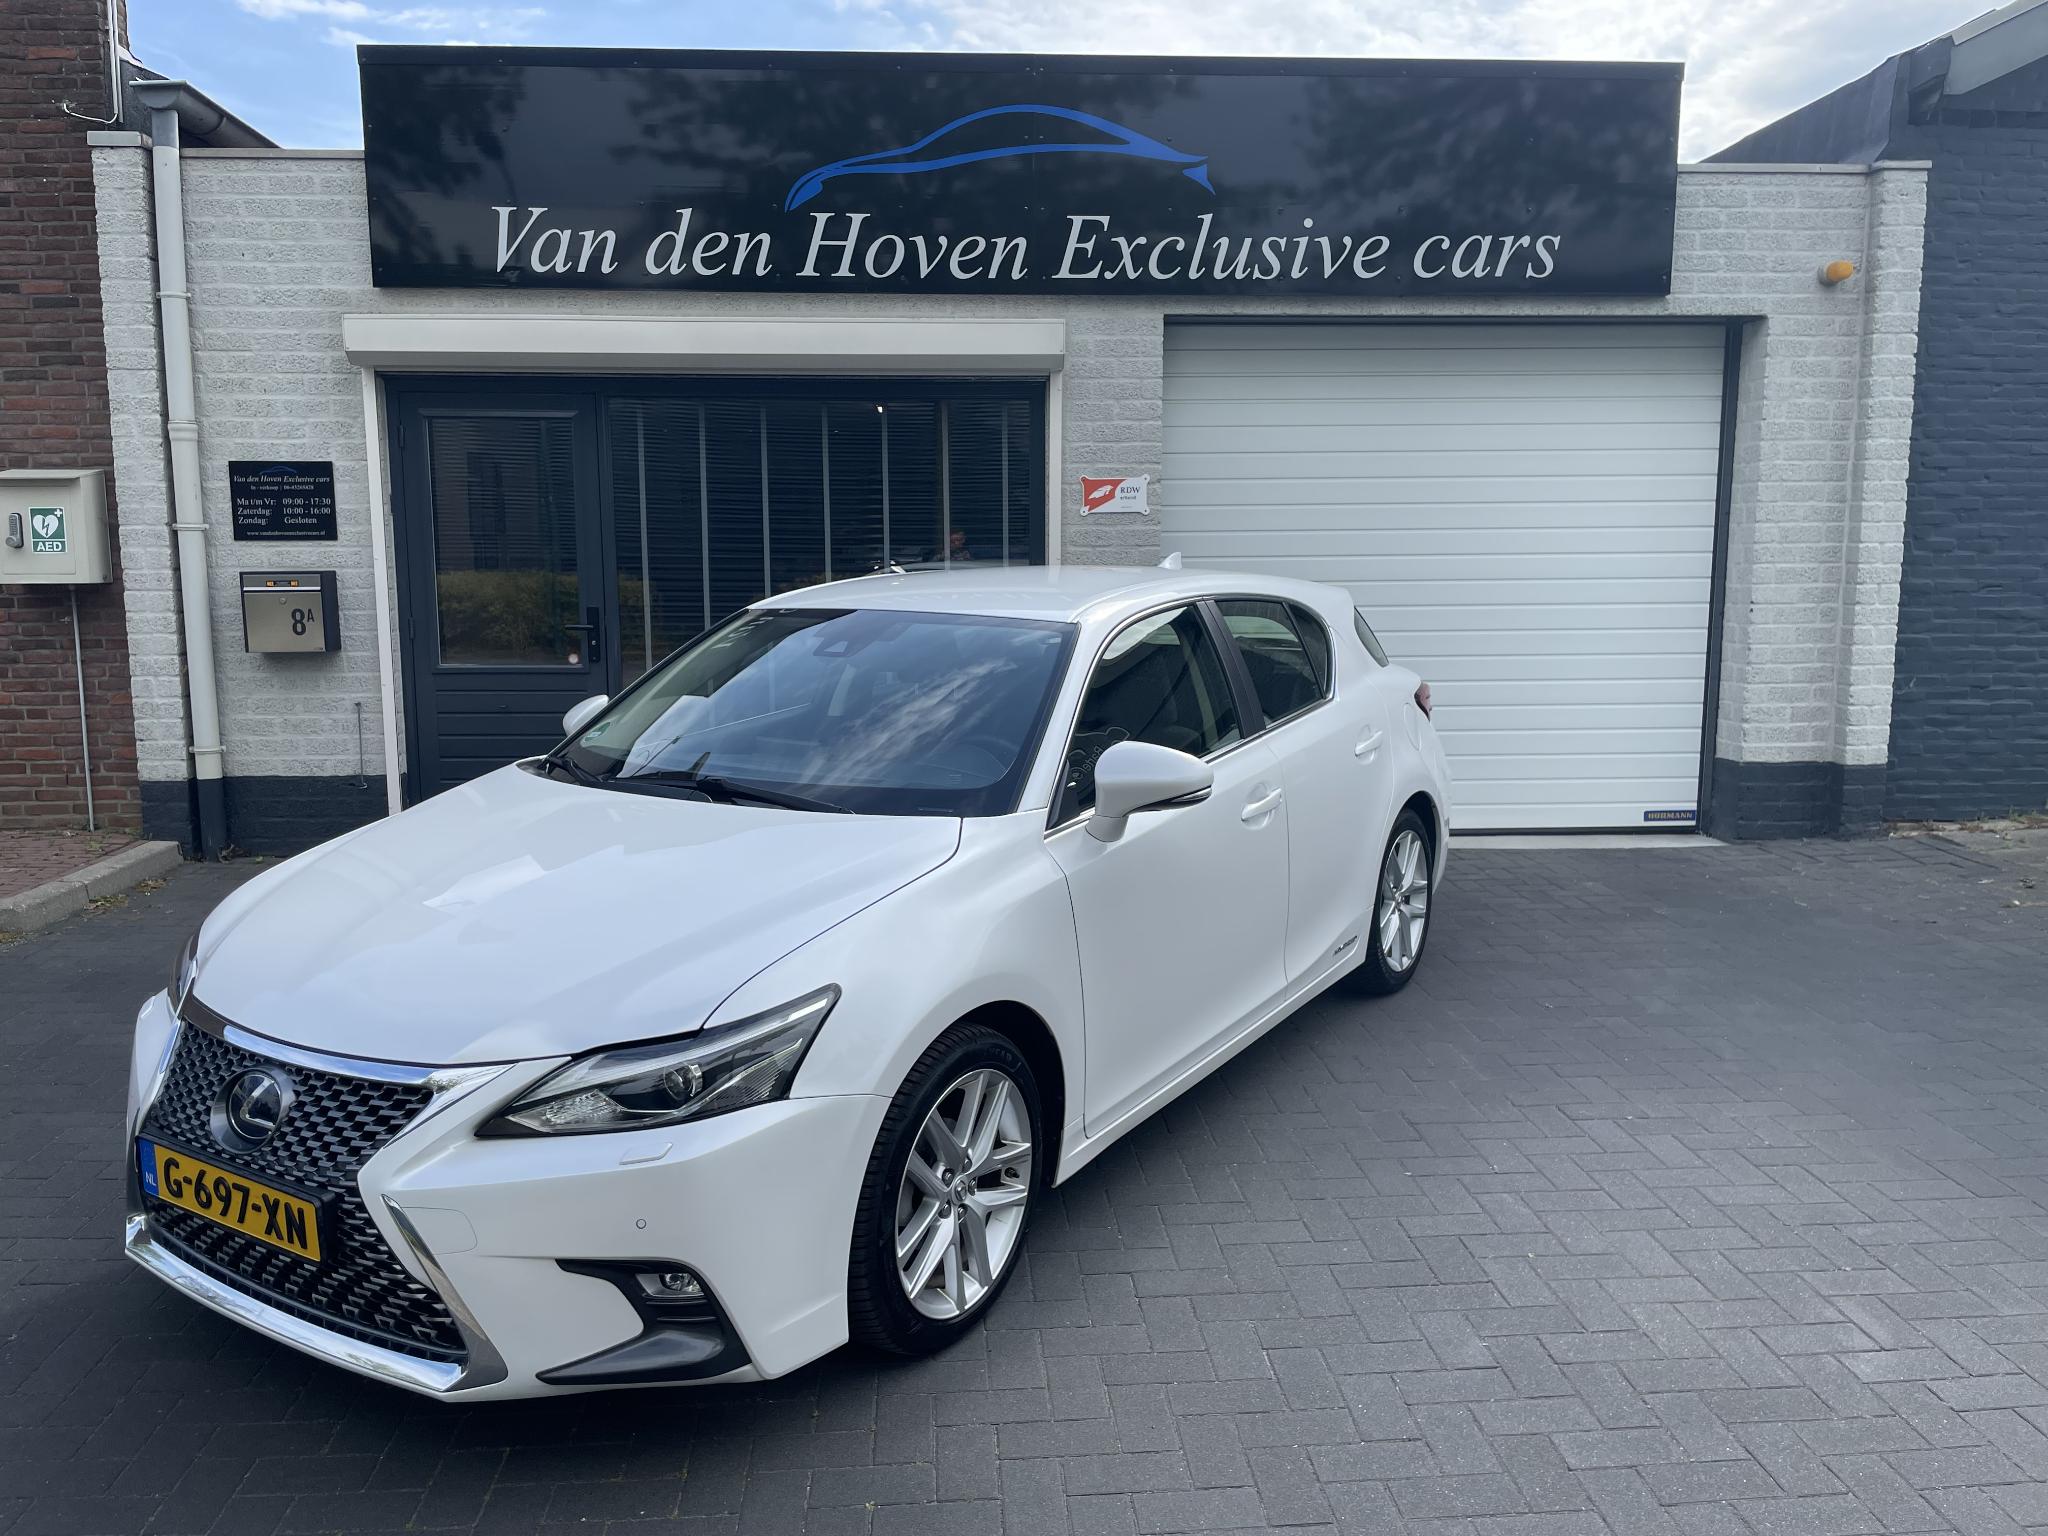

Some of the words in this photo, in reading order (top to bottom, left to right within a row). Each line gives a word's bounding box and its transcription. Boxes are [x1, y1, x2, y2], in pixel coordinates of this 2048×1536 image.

[491, 206, 619, 275] Van
[644, 207, 773, 276] den
[795, 212, 1028, 281] Hoven
[1051, 213, 1391, 281] Exclusive
[1412, 233, 1562, 279] cars
[1120, 486, 1141, 494] RDW
[237, 498, 249, 506] Ma
[264, 498, 277, 506] Vr:
[282, 498, 304, 506] 09:00
[237, 507, 273, 516] Zaterdag:
[282, 507, 304, 515] 10:00
[310, 507, 331, 515] 16:00
[238, 517, 269, 526] Zondag:
[36, 541, 63, 552] AED
[145, 1171, 157, 1187] NL
[163, 1157, 308, 1250] G-697-XN
